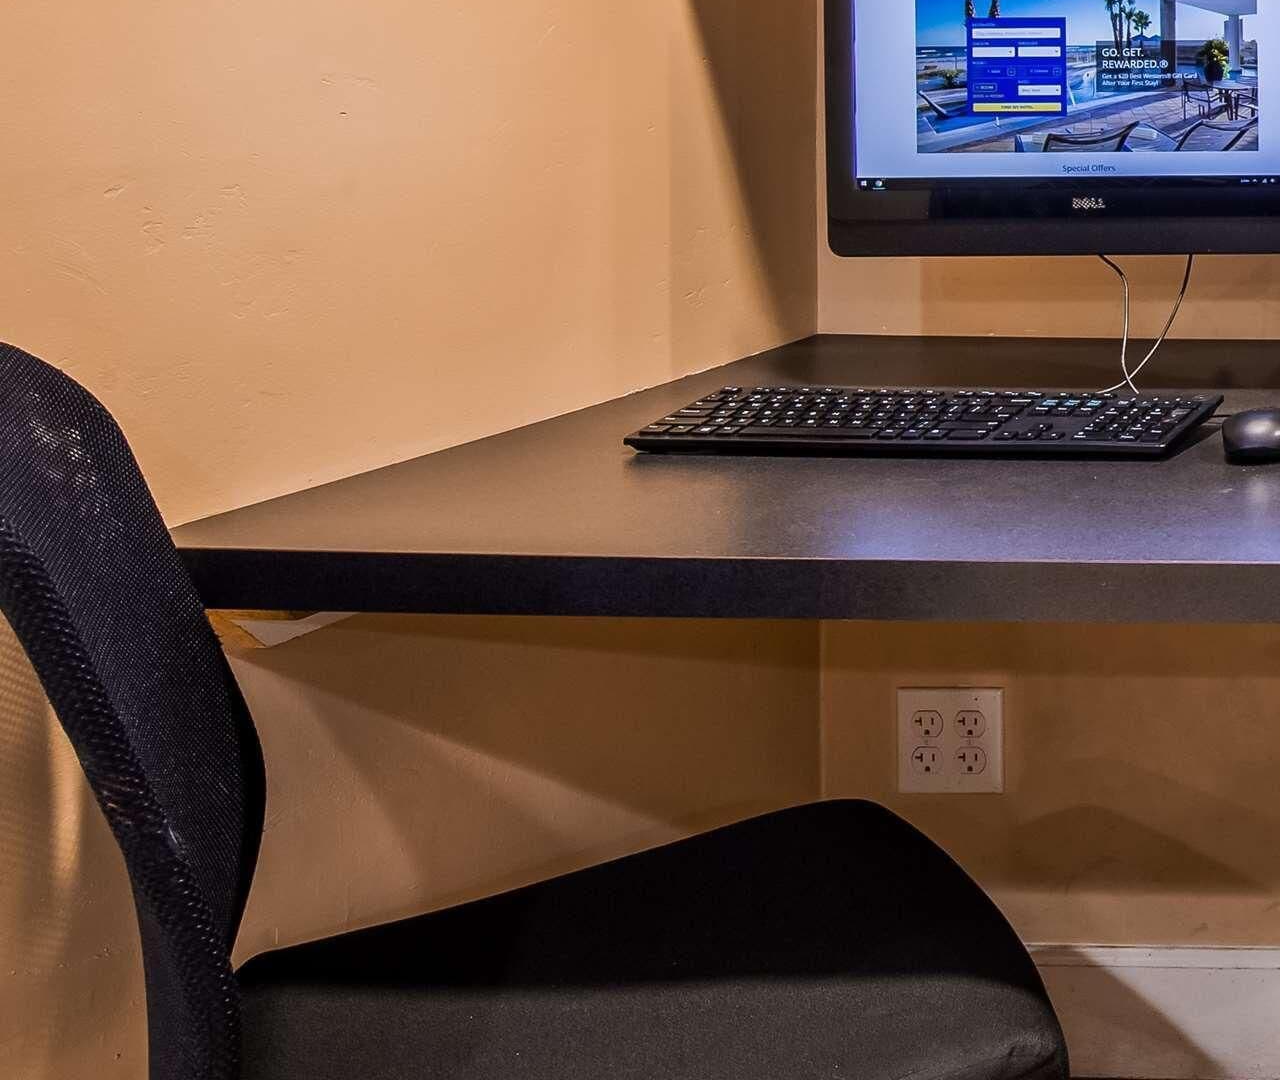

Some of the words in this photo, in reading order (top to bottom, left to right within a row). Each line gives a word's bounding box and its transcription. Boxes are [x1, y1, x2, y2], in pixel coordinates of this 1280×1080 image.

[1102, 48, 1120, 57] GO.
[1122, 48, 1144, 57] GET.
[1062, 165, 1090, 174] Special
[1091, 164, 1116, 172] Offers
[1072, 197, 1106, 210] DELL
